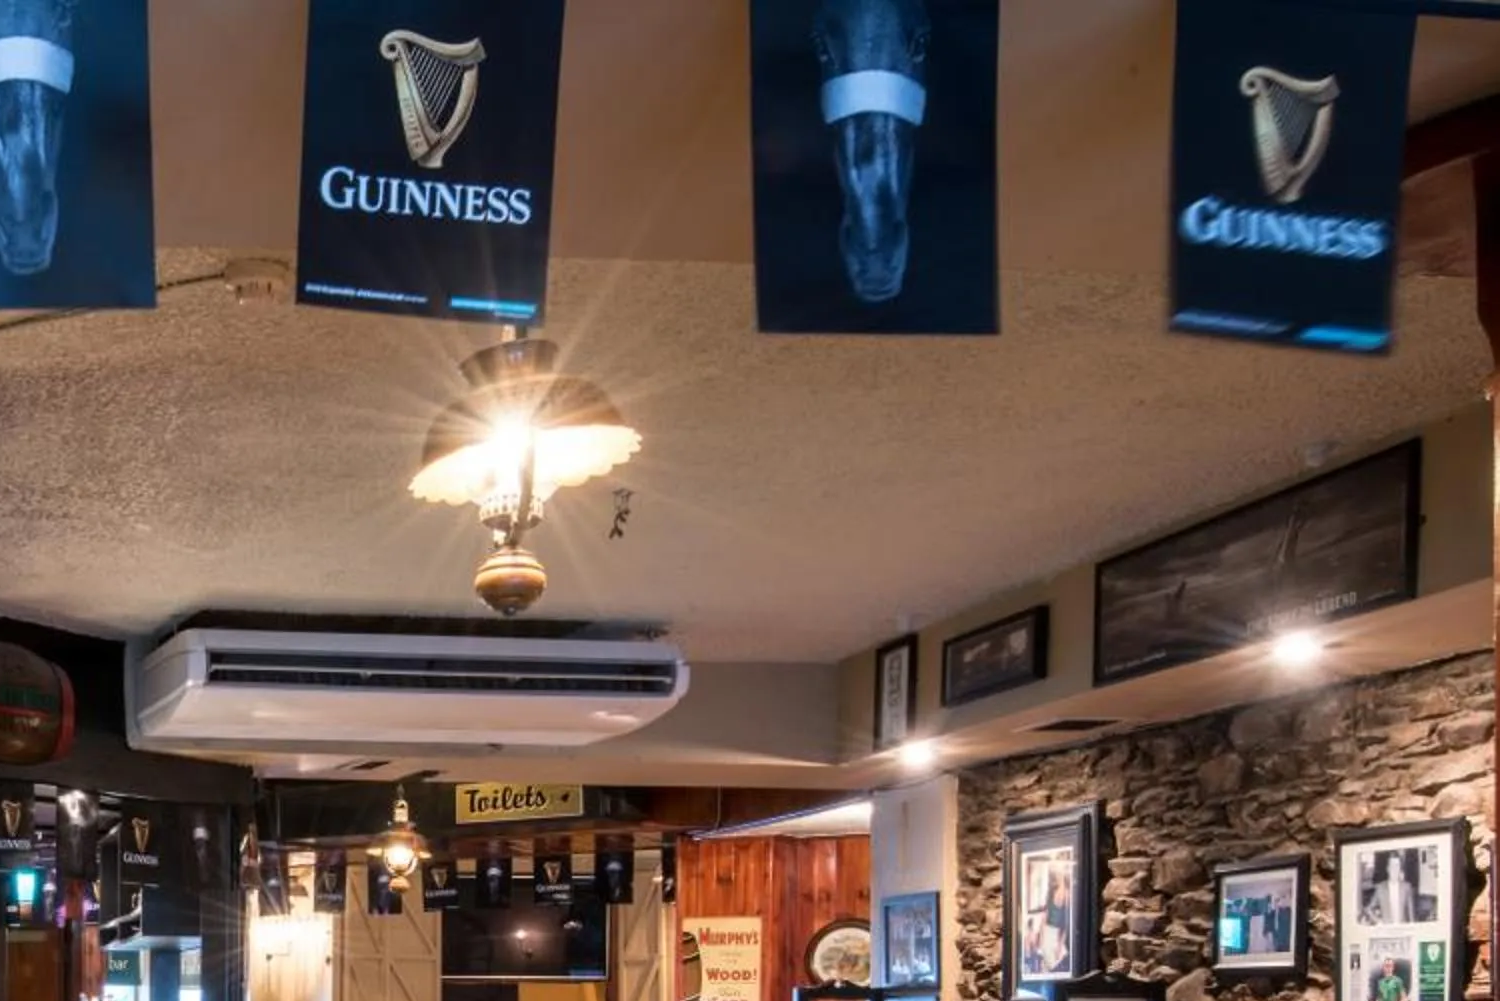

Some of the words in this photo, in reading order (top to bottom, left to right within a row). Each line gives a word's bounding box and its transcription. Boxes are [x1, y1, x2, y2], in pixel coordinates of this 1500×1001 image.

[320, 166, 532, 225] GUINNESS
[1181, 195, 1387, 259] GUINNESS
[464, 785, 547, 813] Toilets
[109, 952, 128, 969] bar
[706, 968, 758, 981] WOOD!
